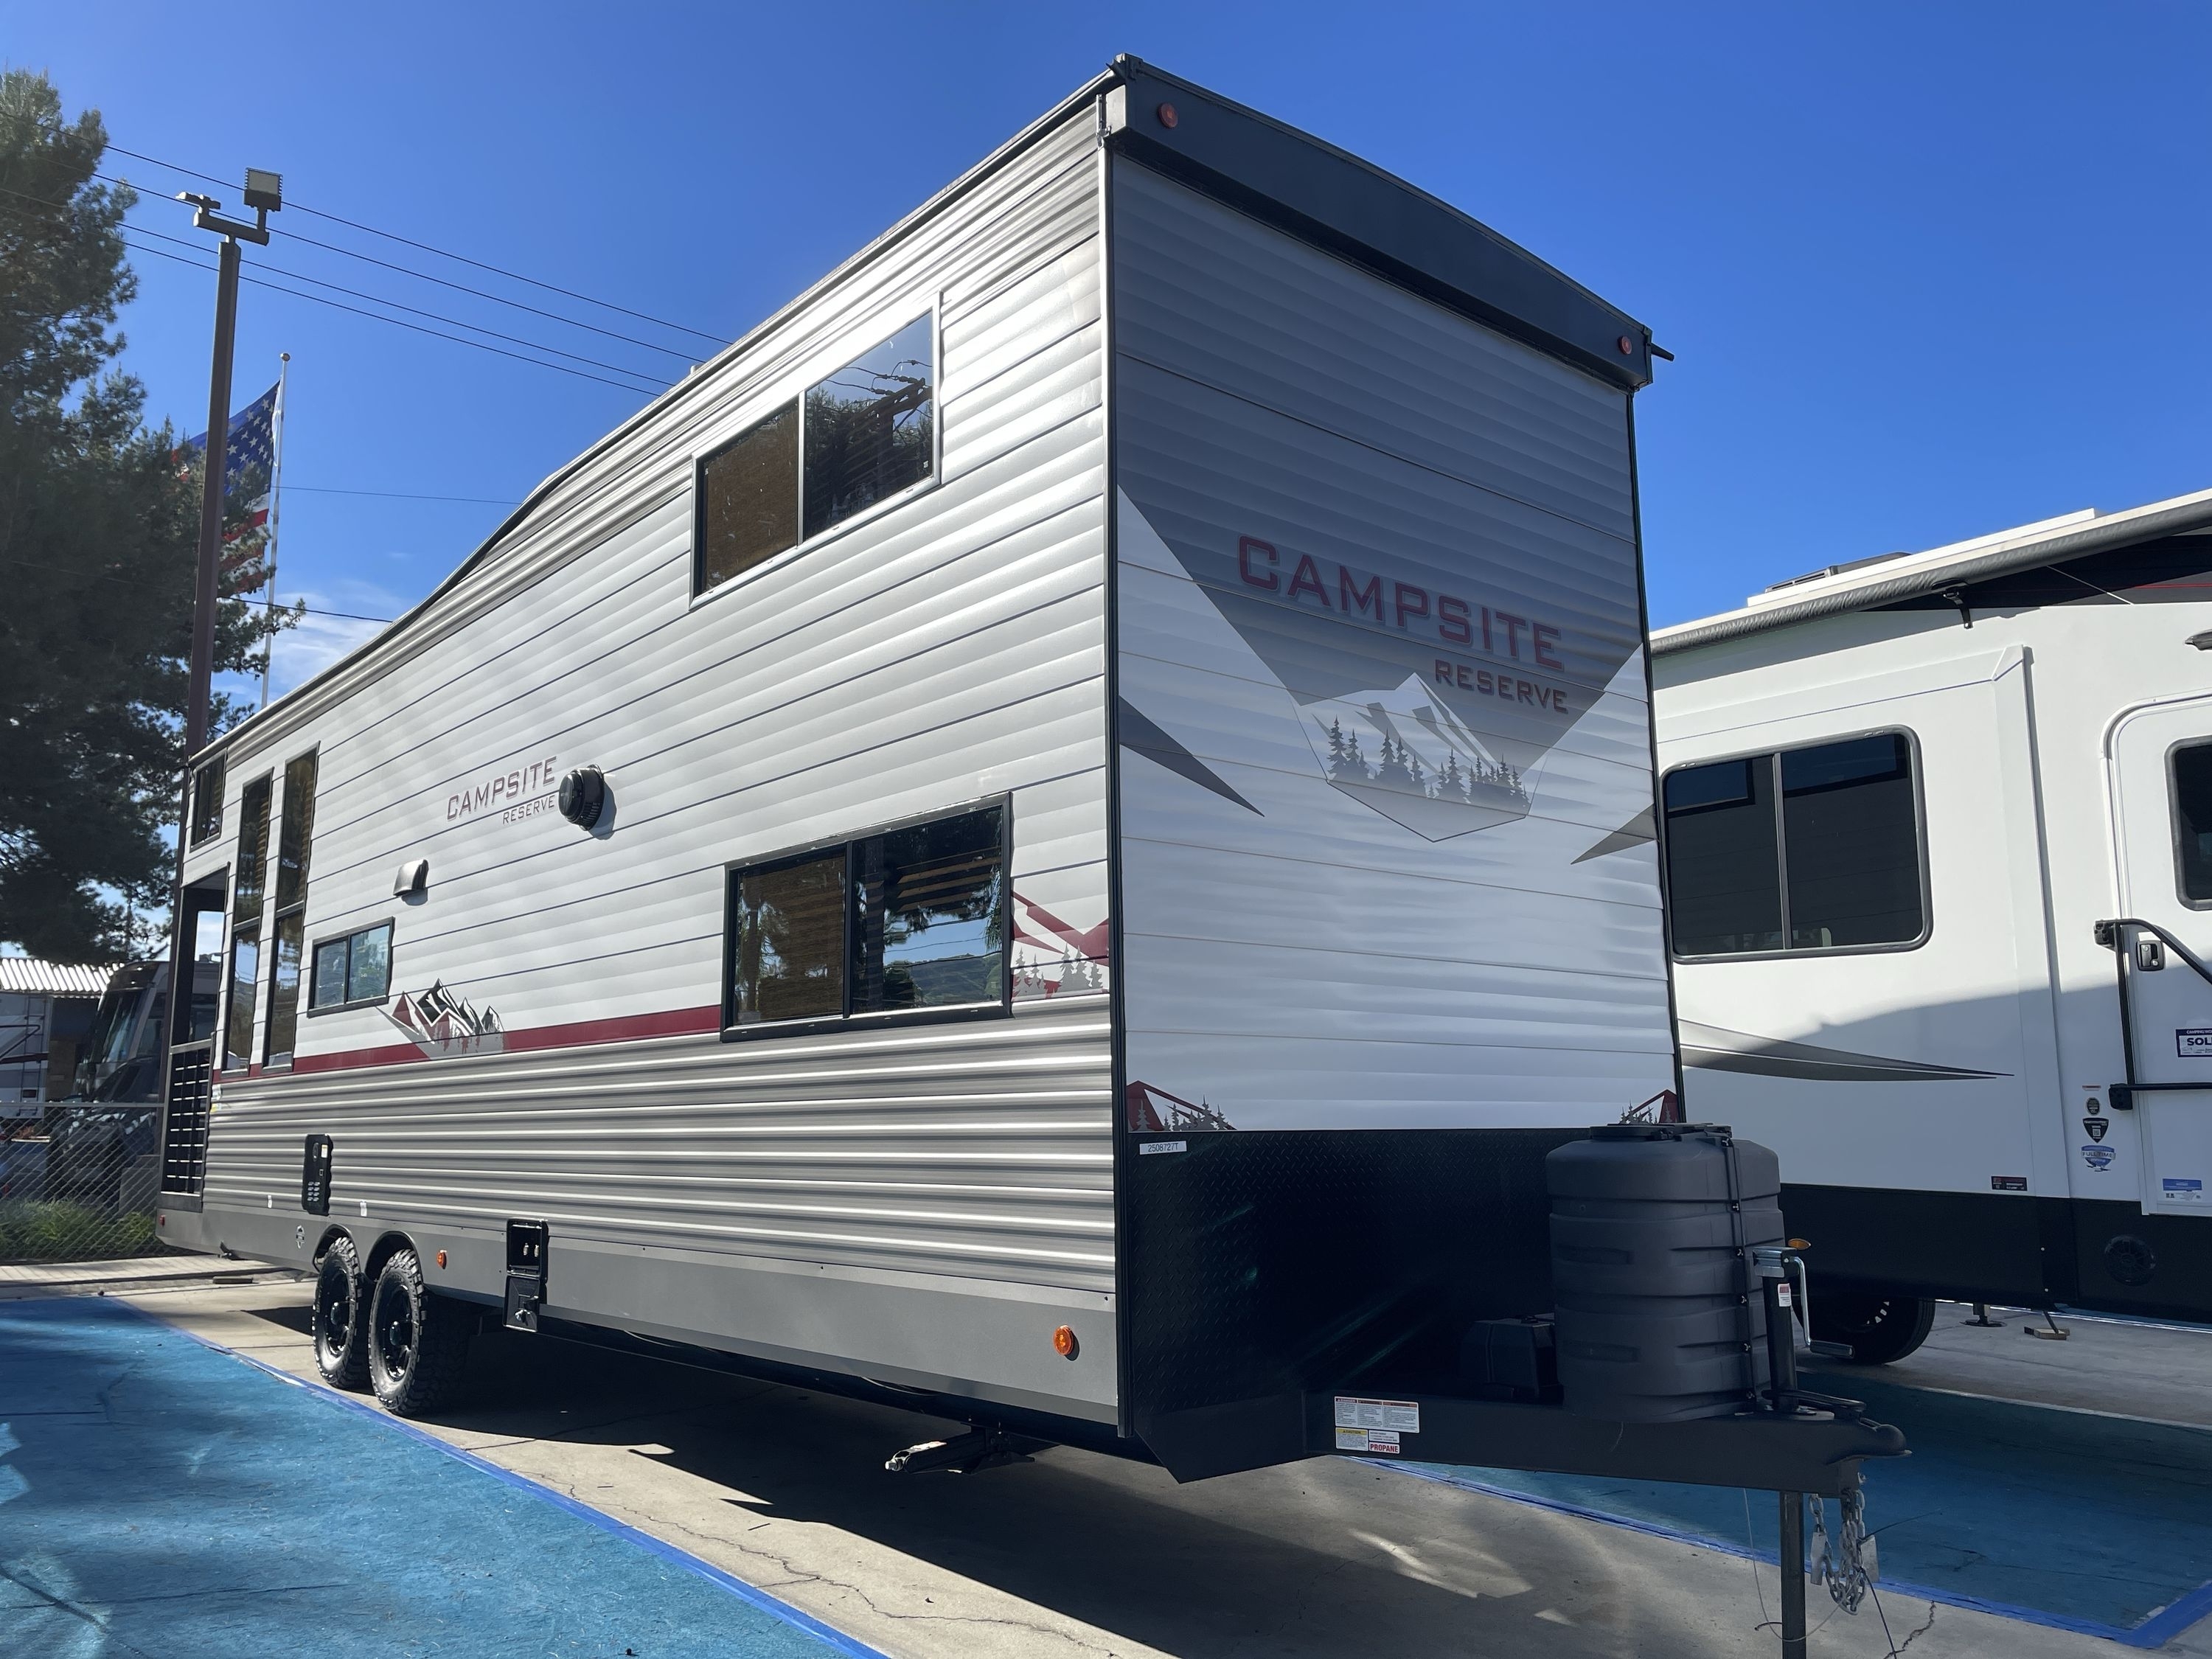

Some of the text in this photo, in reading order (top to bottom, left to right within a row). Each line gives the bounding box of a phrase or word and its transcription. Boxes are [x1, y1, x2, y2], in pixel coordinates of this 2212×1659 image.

[1239, 535, 1564, 671] CAMPSITE
[1434, 658, 1568, 714] RESERVE
[447, 756, 557, 821] CAMPSITE
[503, 795, 555, 824] RESERVE
[2187, 1037, 2212, 1046] SOL
[1148, 1143, 1178, 1152] 2508727T
[1370, 1444, 1399, 1453] PROPANE
